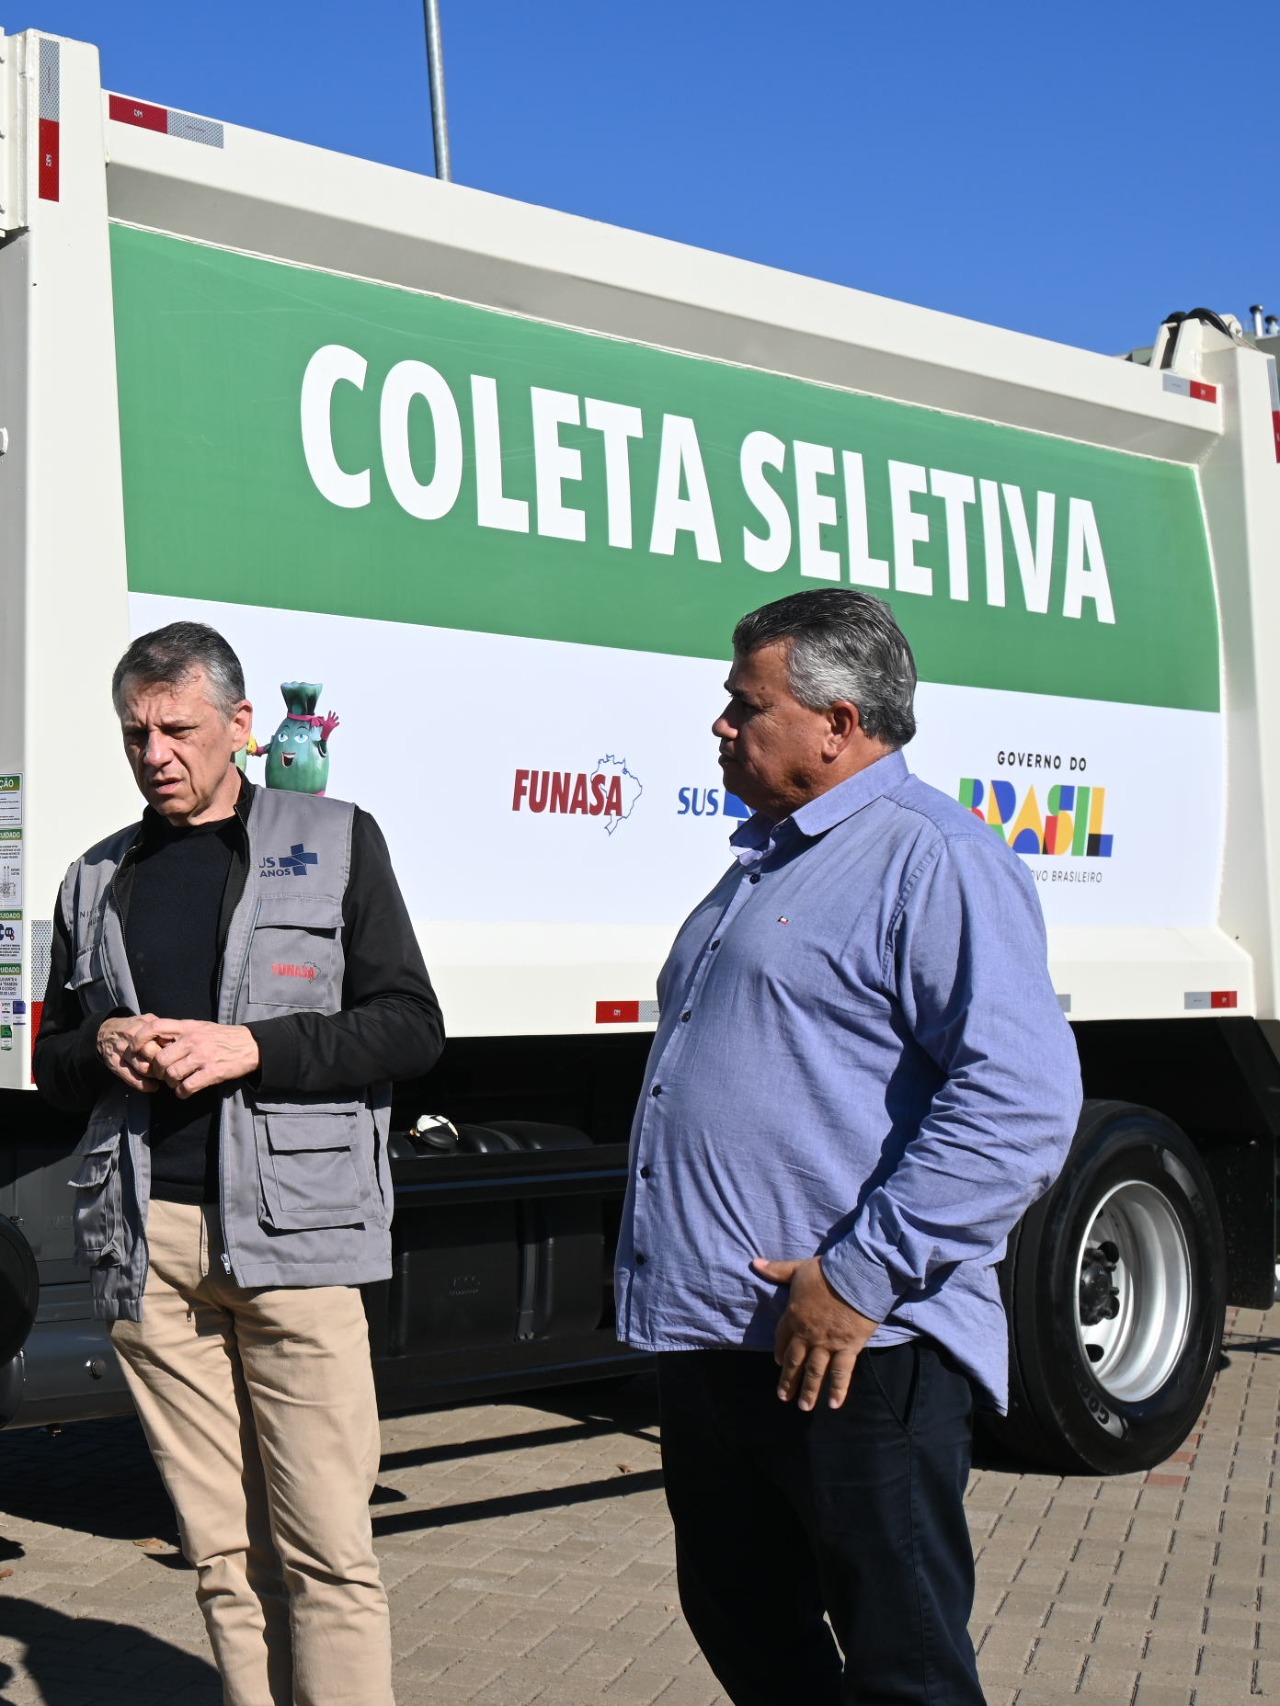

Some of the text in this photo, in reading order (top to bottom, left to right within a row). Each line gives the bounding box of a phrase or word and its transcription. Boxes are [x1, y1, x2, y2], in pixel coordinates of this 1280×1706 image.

[300, 344, 1116, 624] COLETA SELETIVA
[997, 750, 1087, 772] GOVERNO DO
[512, 769, 622, 816] FUNASA
[677, 787, 719, 816] SUS
[959, 778, 1113, 858] BRASIL
[260, 868, 291, 878] ANOS
[1052, 870, 1103, 883] BRASILEIRO
[272, 963, 316, 979] FUNASA
